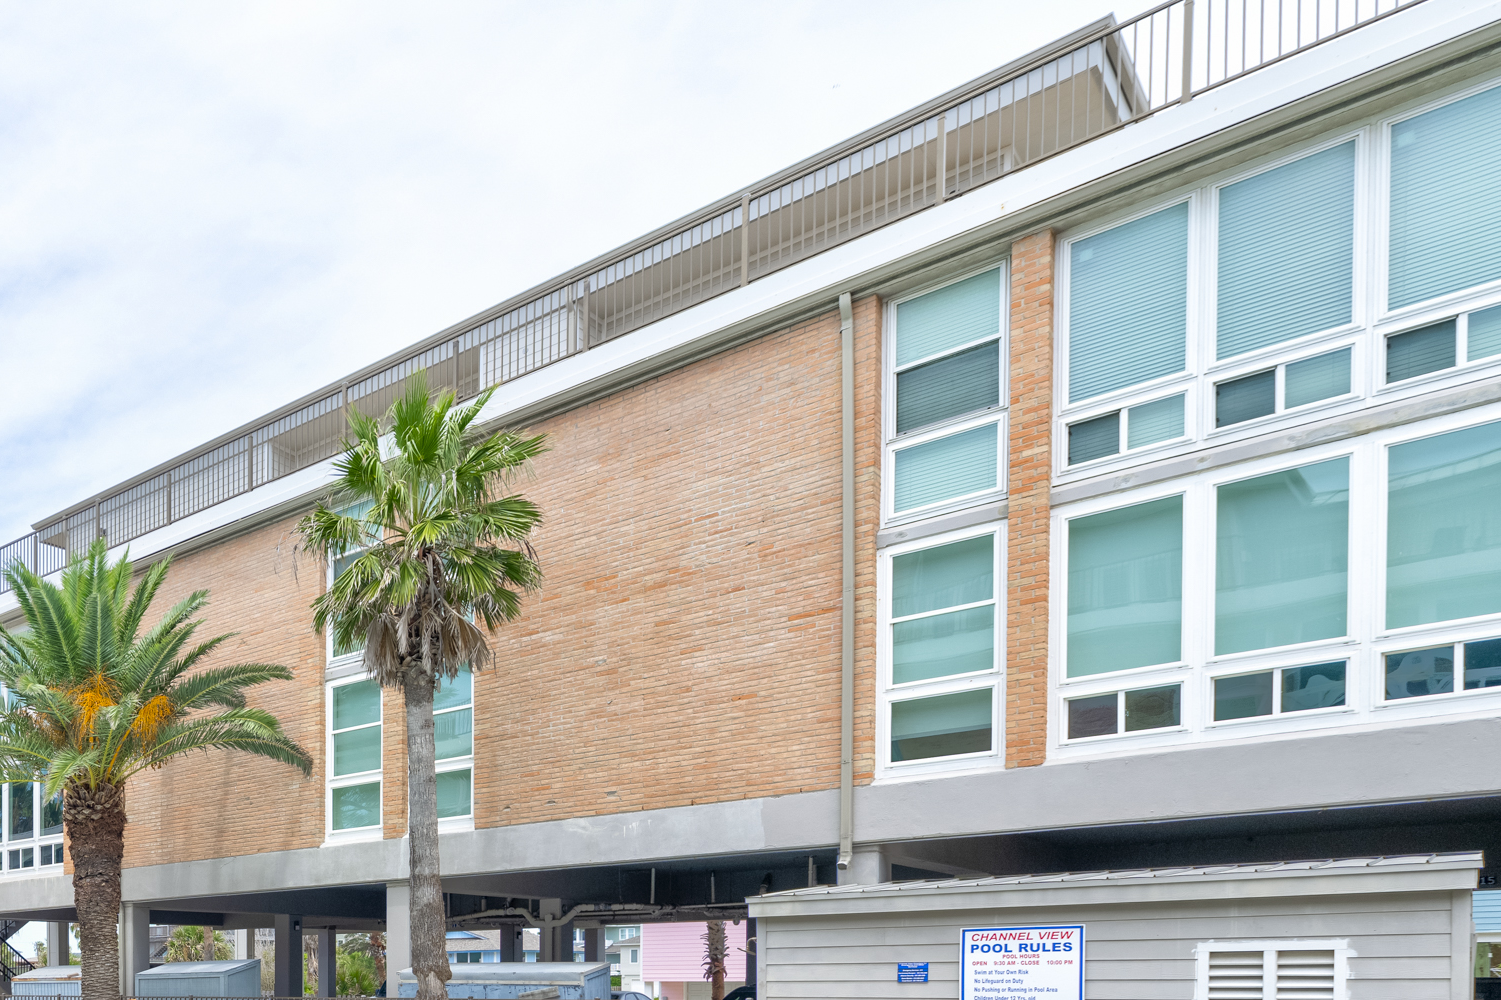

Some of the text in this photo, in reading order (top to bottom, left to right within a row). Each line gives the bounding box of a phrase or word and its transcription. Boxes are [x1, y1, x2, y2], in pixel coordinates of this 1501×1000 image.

[971, 930, 1074, 942] CHANNEL VIEW
[970, 941, 1073, 953] POOL RULES
[981, 986, 1001, 994] Pushing
[1007, 986, 1027, 994] Running
